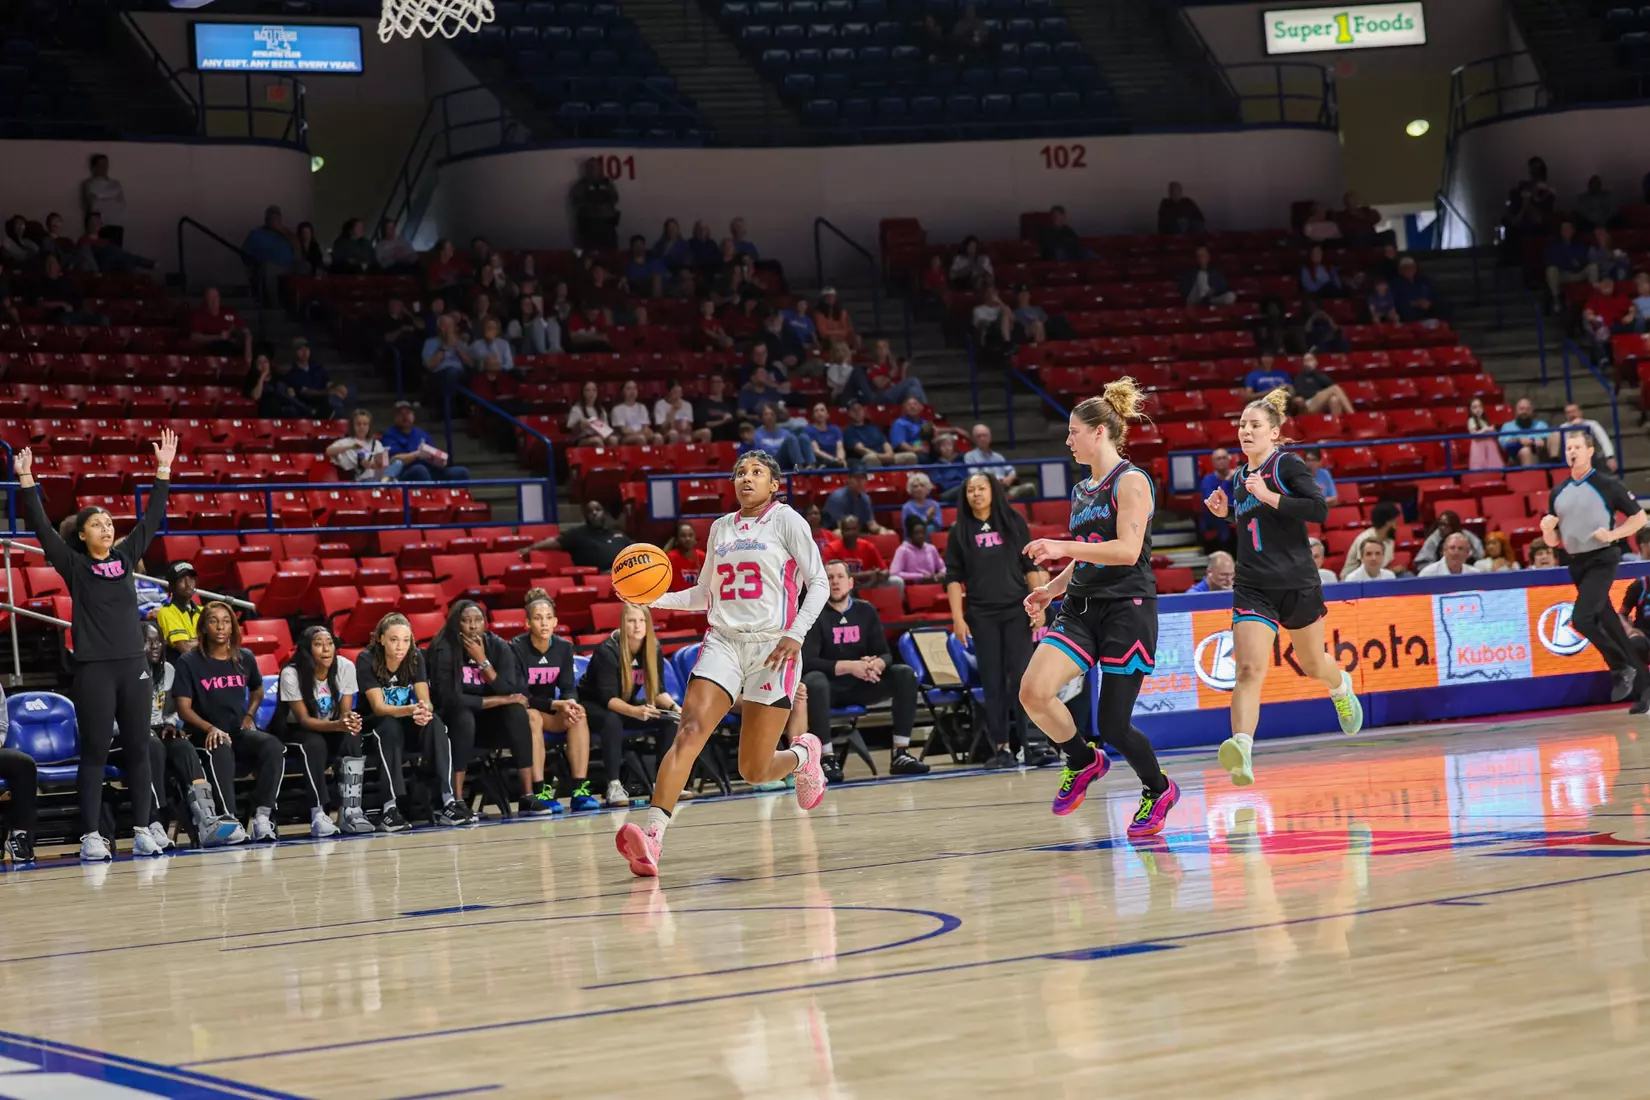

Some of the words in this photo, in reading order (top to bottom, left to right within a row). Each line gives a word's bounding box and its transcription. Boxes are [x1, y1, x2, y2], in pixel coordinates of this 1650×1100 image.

[1274, 21, 1332, 42] Super
[1333, 12, 1354, 44] 1
[1353, 13, 1414, 33] Foods
[202, 59, 221, 68] ANY
[250, 60, 269, 68] ANY
[298, 60, 329, 69] EVERY
[1040, 144, 1087, 169] 102
[1247, 518, 1263, 552] 1
[614, 553, 652, 575] Wilson
[717, 562, 763, 601] 23
[832, 625, 861, 644] FIU
[1273, 624, 1430, 678] Kbota
[1457, 643, 1527, 665] Kubota
[528, 667, 560, 685] FIU
